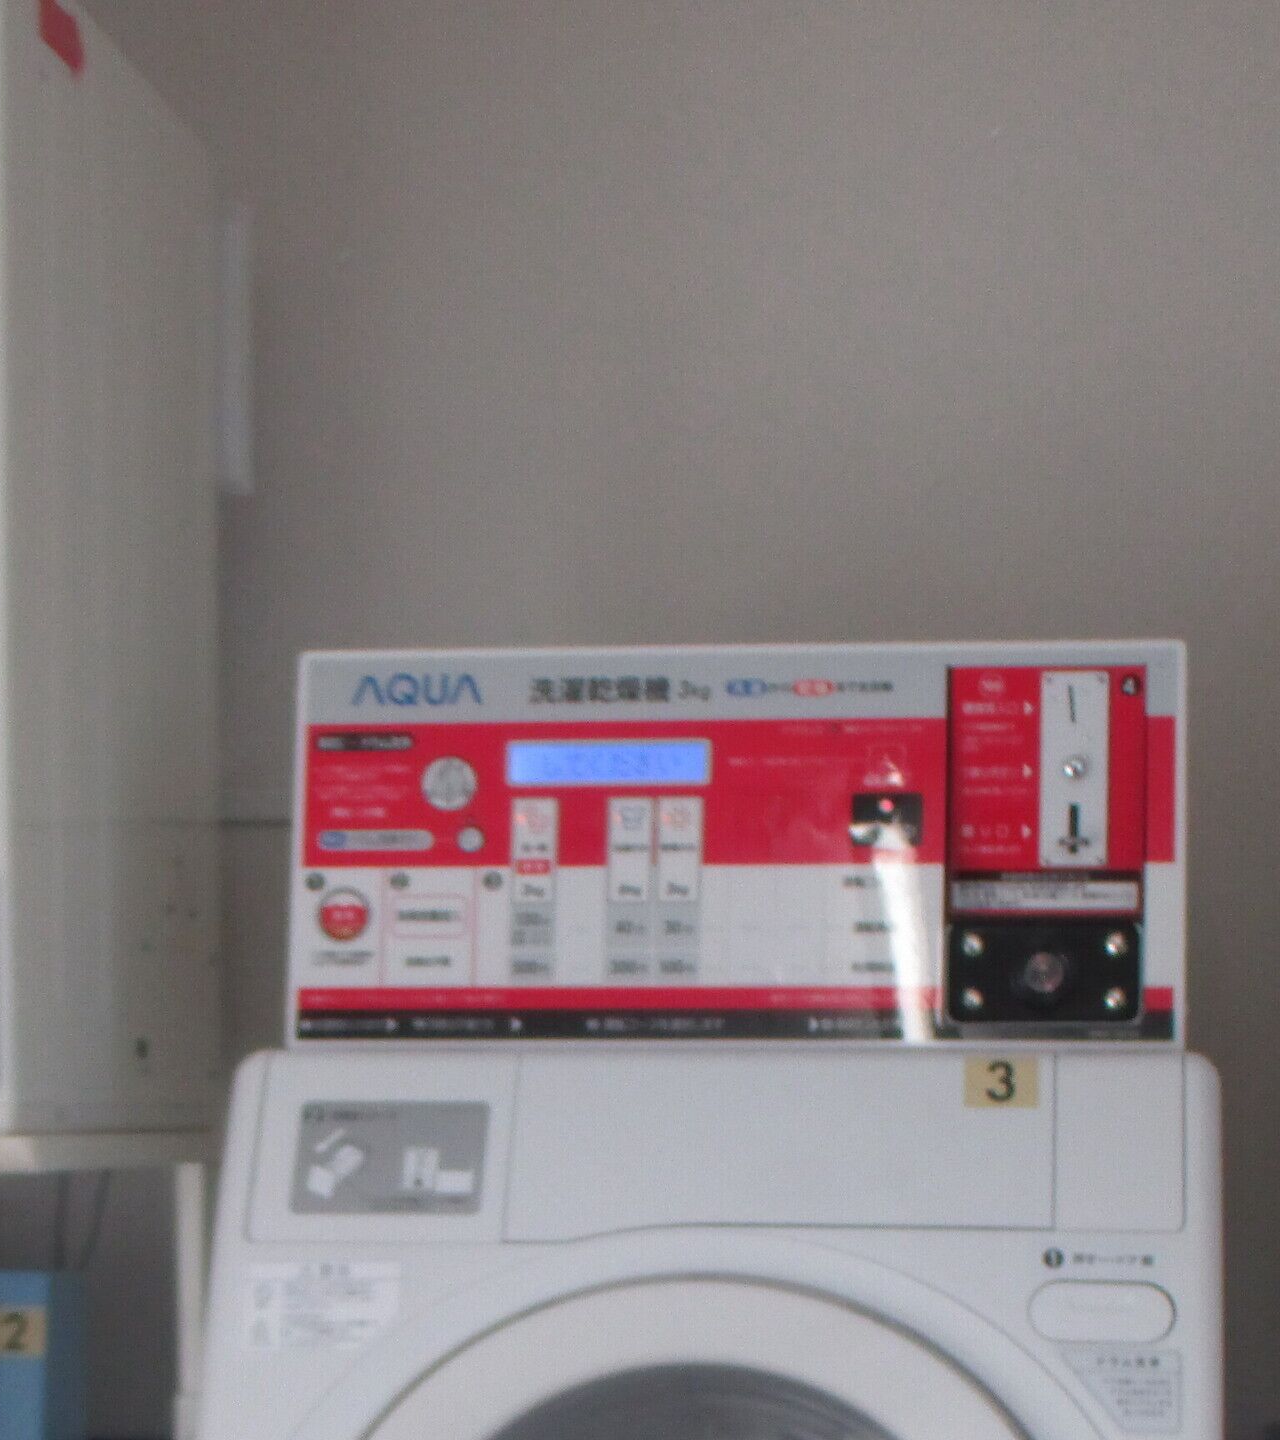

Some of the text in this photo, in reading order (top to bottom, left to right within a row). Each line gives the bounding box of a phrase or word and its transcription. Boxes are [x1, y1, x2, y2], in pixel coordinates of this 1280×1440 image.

[352, 674, 484, 707] AQUA
[986, 1060, 1016, 1102] 3
[1, 1312, 28, 1351] 2
